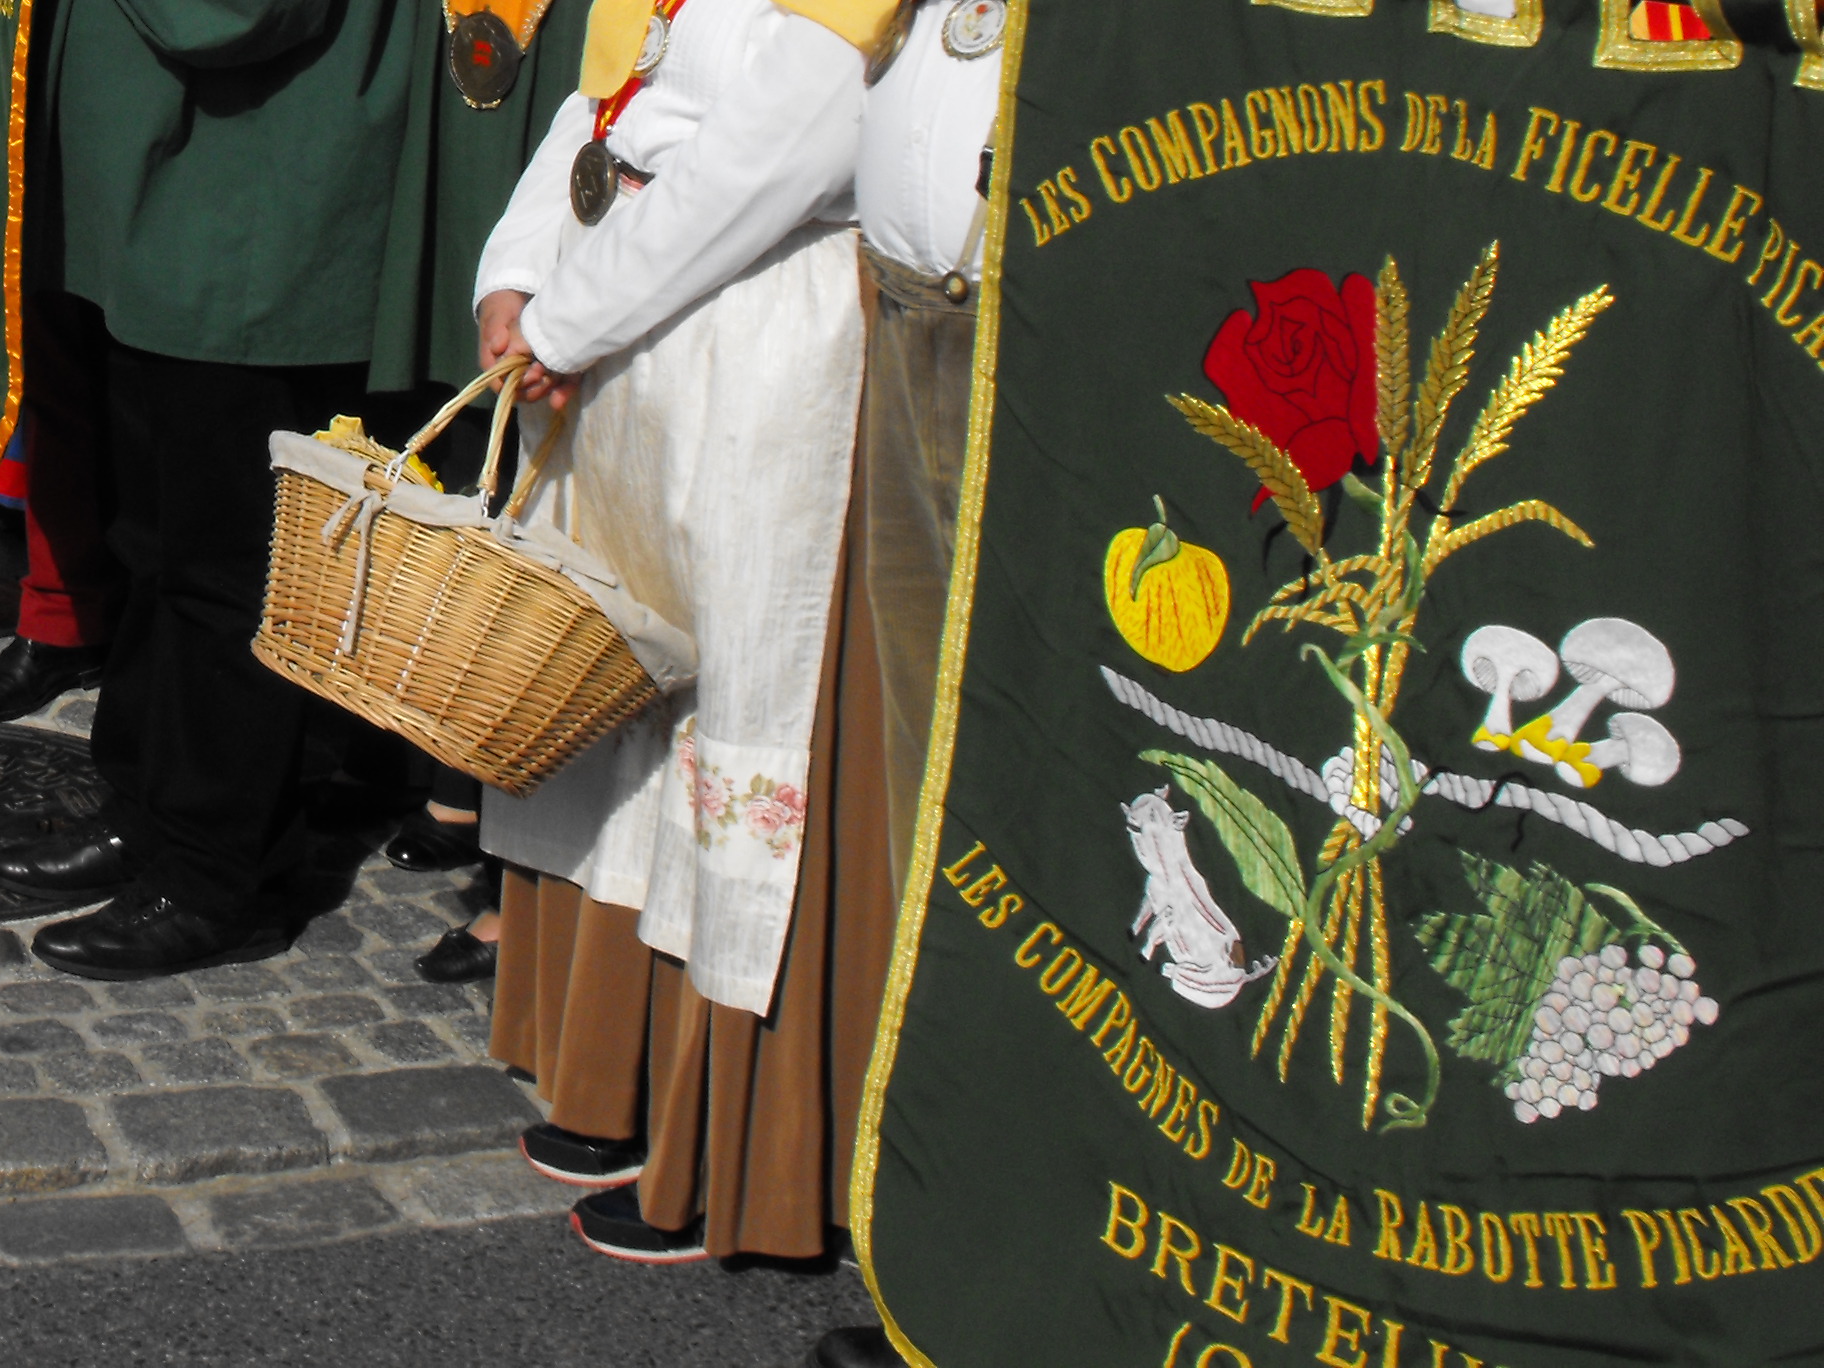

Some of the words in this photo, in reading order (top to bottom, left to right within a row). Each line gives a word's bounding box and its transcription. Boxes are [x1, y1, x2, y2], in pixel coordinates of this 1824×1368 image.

[1018, 168, 1093, 248] LES
[1090, 79, 1388, 204] COMPAGNONS
[1400, 91, 1444, 157] DE
[1449, 101, 1499, 171] LA
[1511, 106, 1764, 264] FICELLE
[941, 842, 1014, 930] LES
[1015, 925, 1223, 1163] COMPAGNES
[1221, 1136, 1278, 1210] DE
[1295, 1182, 1351, 1247] LA
[1372, 1188, 1617, 1291] RABOTTE
